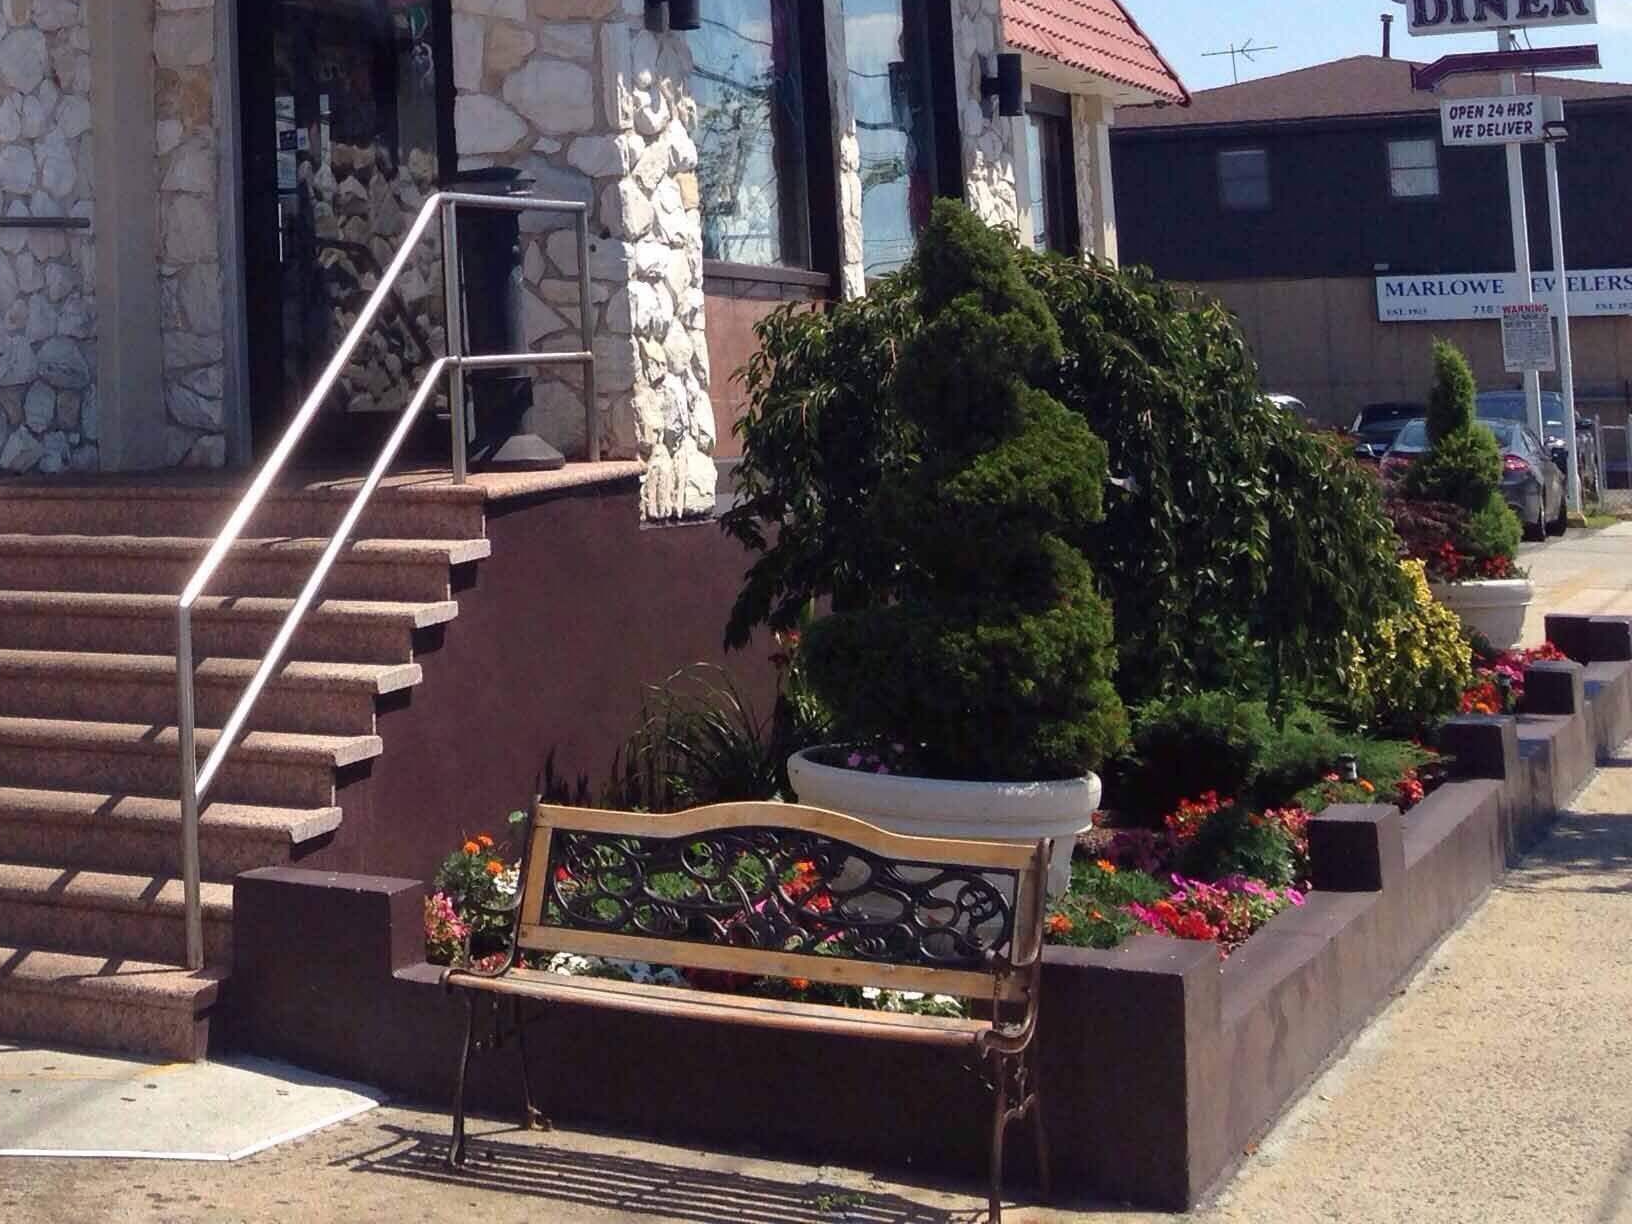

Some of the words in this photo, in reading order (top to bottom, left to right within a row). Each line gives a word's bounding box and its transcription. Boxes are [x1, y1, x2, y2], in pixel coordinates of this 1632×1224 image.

[1449, 104, 1484, 121] OPEN
[1488, 103, 1504, 118] 24
[1507, 101, 1533, 117] HRS
[1452, 124, 1474, 139] WE
[1477, 120, 1533, 137] DELIVER
[1385, 279, 1505, 297] MARLOWE
[1531, 274, 1632, 293] EWELERS
[1503, 303, 1549, 313] WARNING
